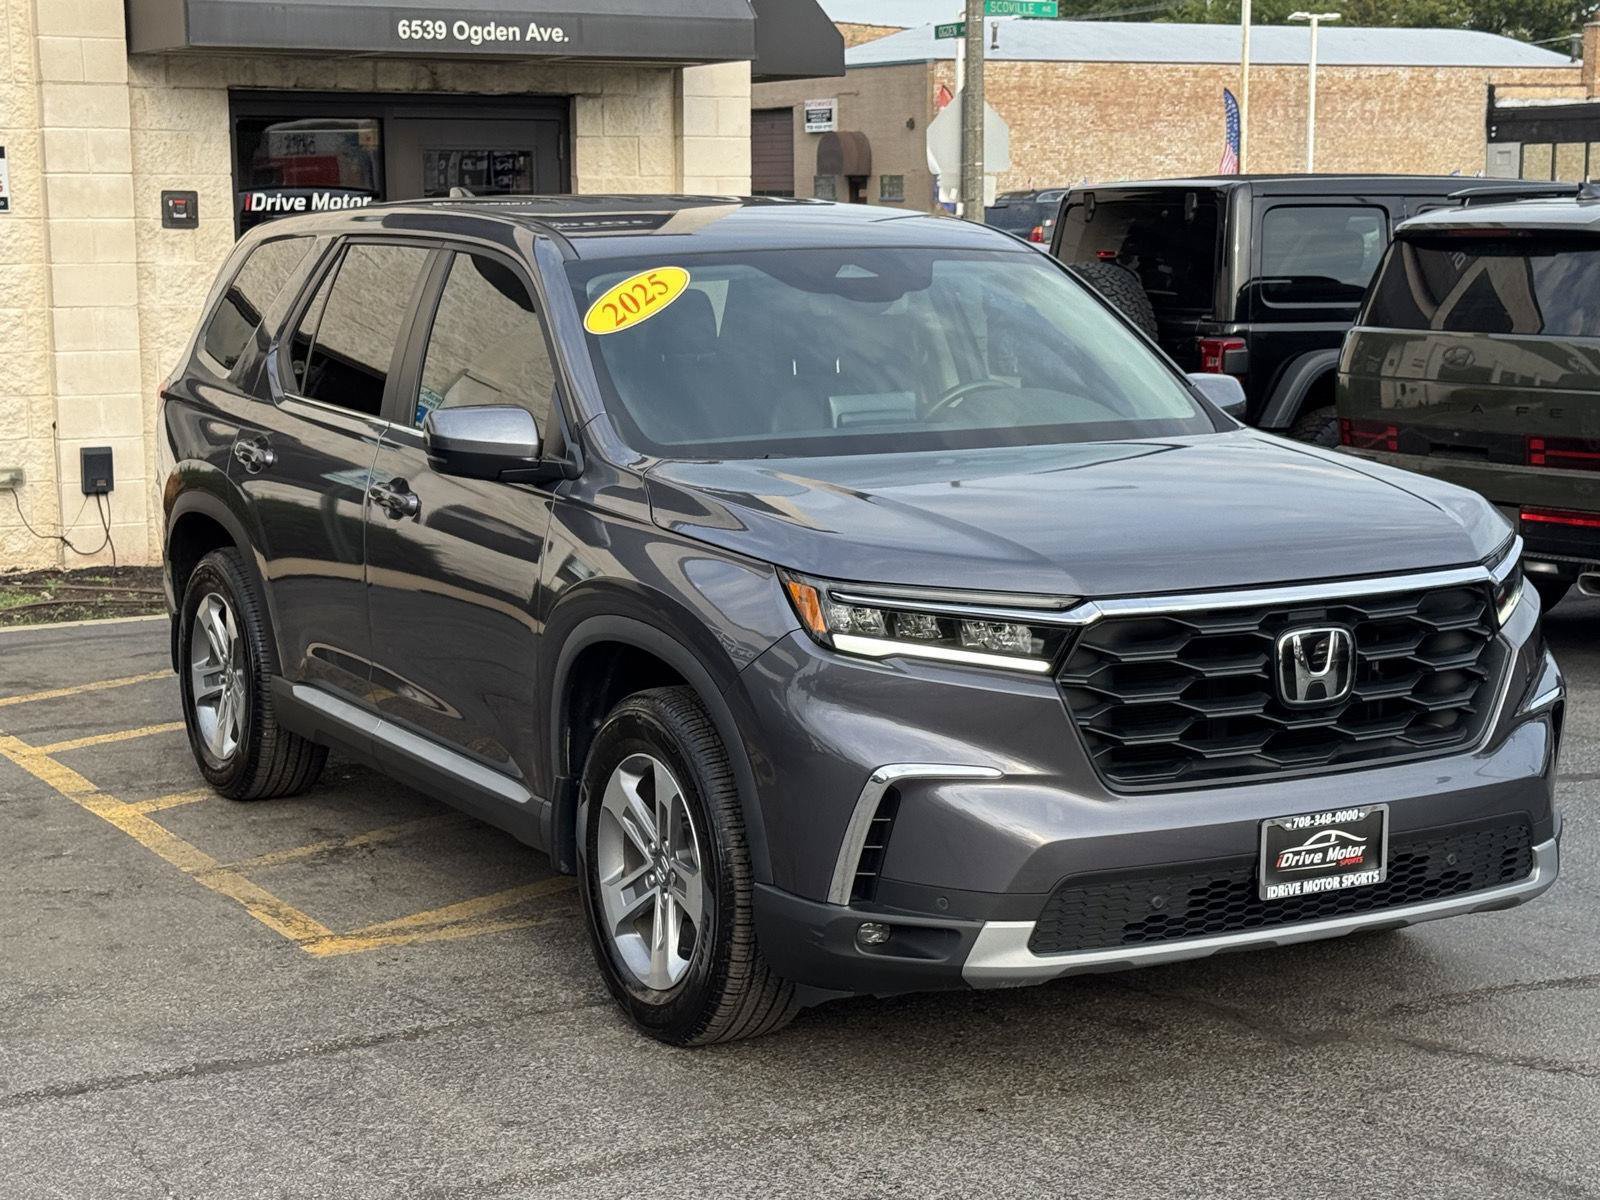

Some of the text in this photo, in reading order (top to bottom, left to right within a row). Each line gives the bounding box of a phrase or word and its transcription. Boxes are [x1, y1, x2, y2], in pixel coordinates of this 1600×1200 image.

[990, 1, 1035, 14] SCOVILLE
[397, 19, 570, 46] 6539 Ogden Ave.
[311, 192, 372, 211] Motor
[602, 273, 669, 327] 2025
[1514, 406, 1564, 419] FE
[1293, 809, 1358, 829] 708-348-0000
[1276, 845, 1366, 868] iDrive Motor
[1267, 870, 1380, 899] IDRIVE MOTOR SPORTS
